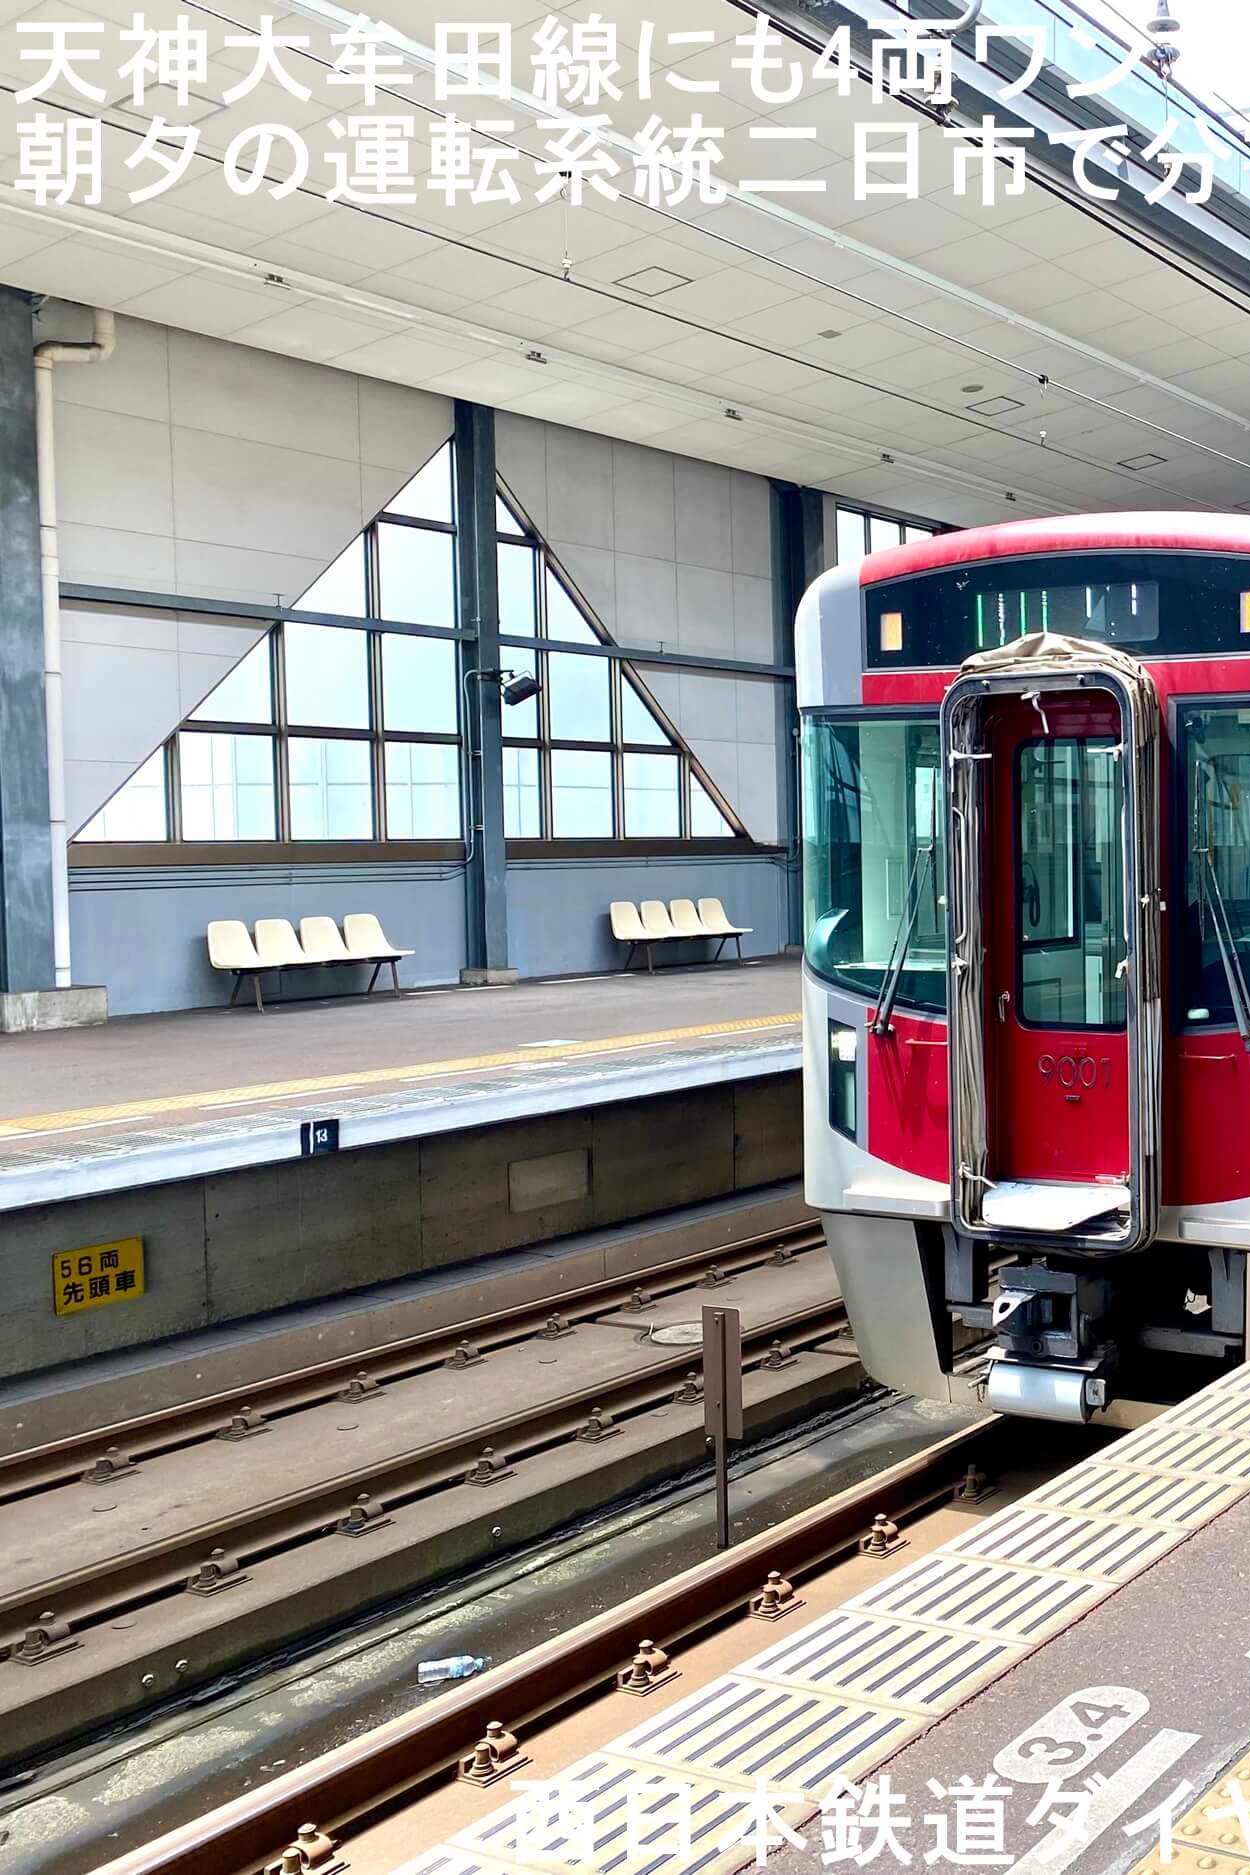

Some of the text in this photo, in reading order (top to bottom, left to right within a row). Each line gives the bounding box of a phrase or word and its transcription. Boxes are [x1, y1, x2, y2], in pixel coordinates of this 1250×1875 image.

[1037, 1054, 1113, 1089] 9001
[315, 1127, 329, 1144] 13
[62, 1269, 137, 1306] 先頭車
[1017, 1700, 1132, 1766] 3.4
